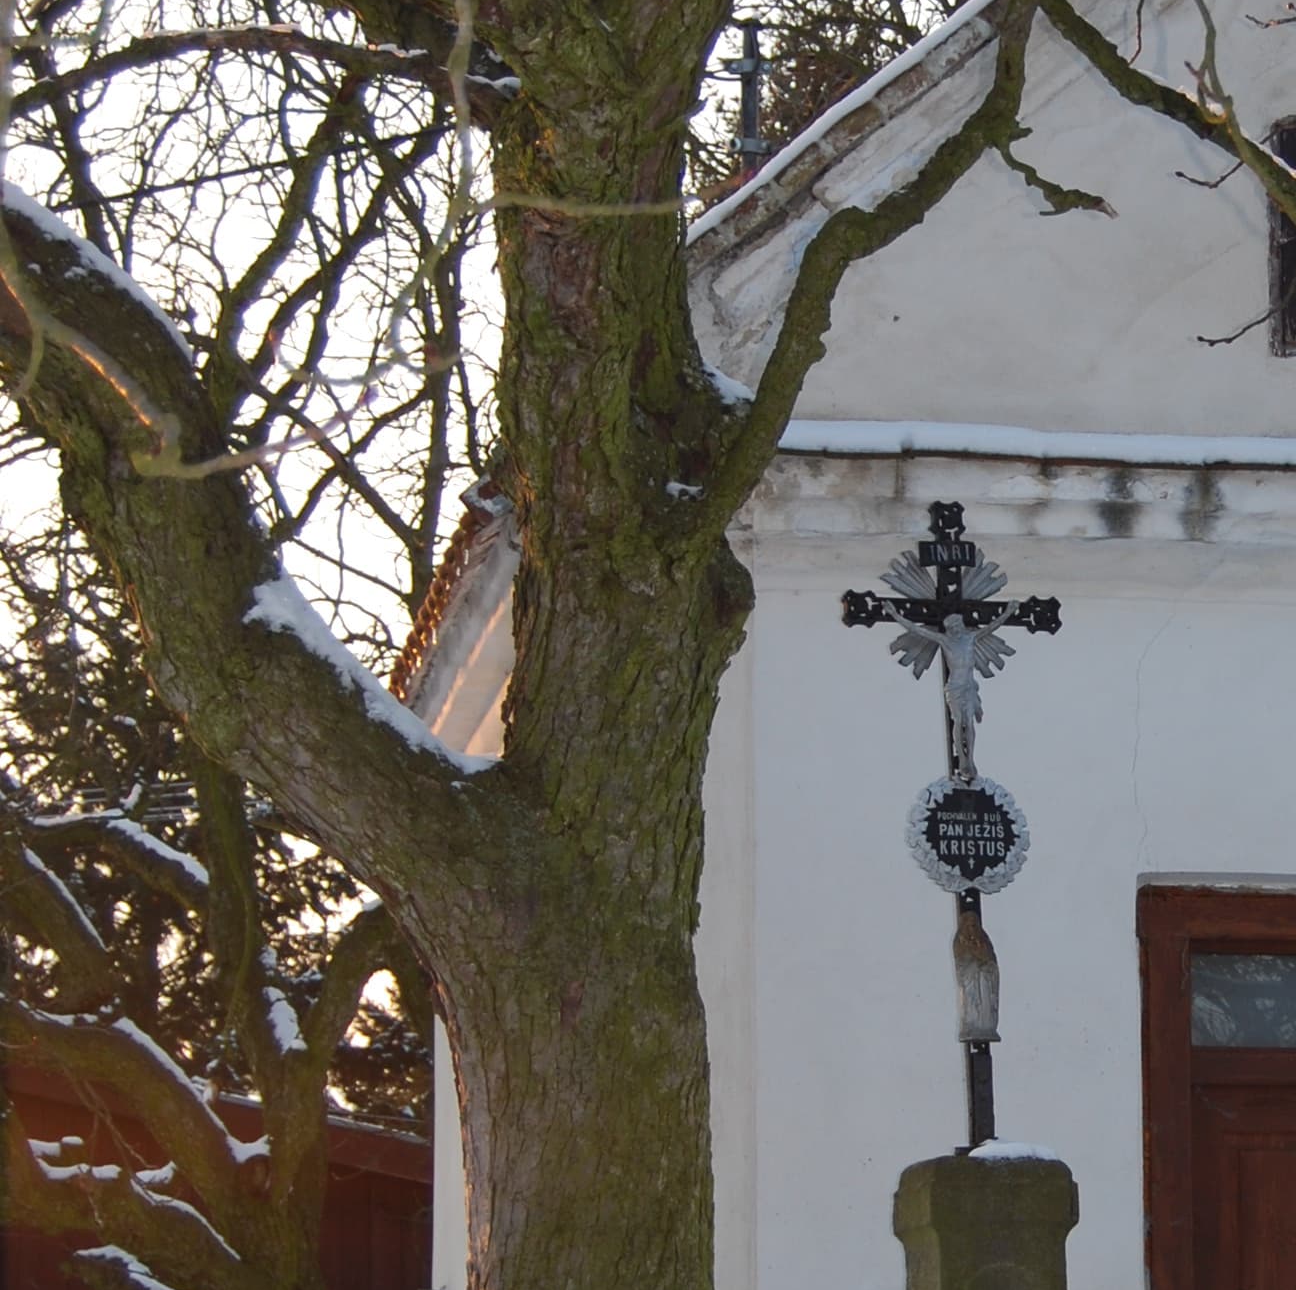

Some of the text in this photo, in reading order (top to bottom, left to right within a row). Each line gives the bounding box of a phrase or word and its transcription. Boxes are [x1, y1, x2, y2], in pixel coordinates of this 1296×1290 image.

[929, 544, 973, 562] INRI
[938, 821, 963, 837] PÁN
[939, 839, 1006, 857] KRISTUS
